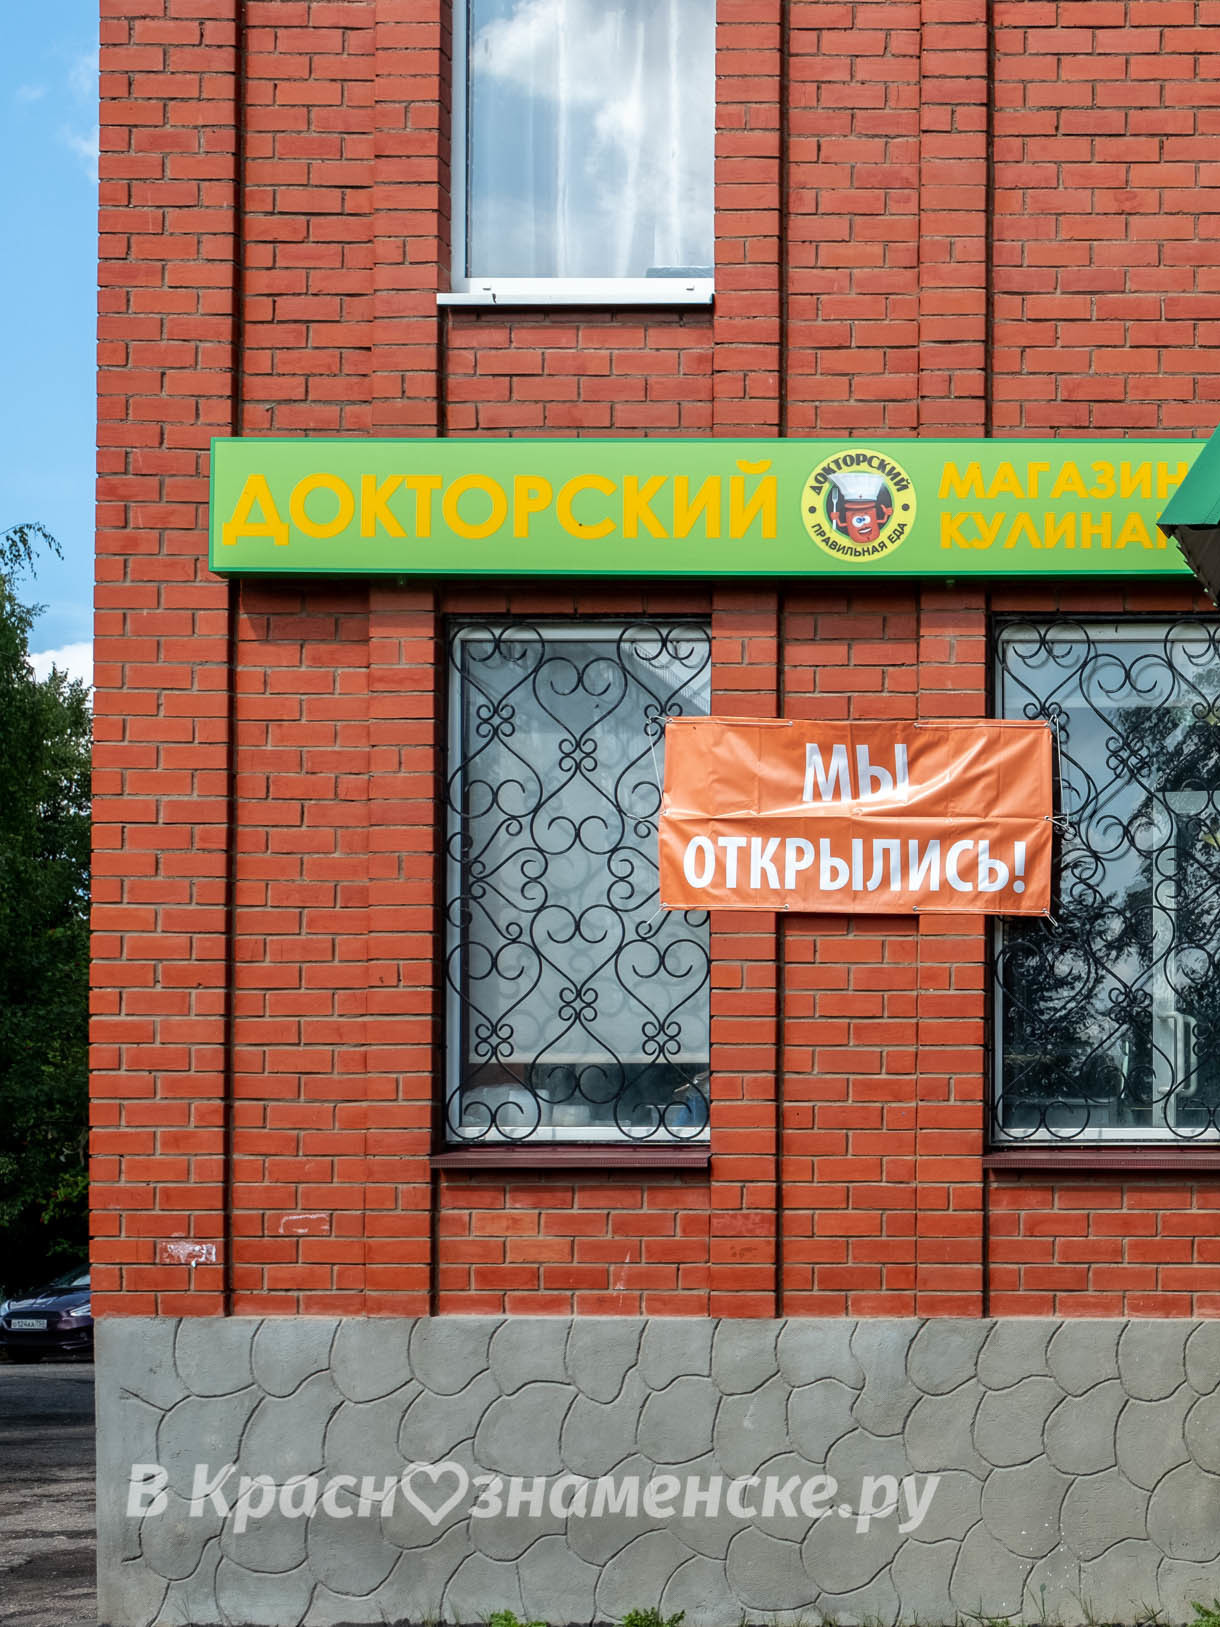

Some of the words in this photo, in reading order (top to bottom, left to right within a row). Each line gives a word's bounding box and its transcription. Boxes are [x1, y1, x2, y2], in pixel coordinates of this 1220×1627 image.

[222, 459, 778, 545] ДОКТОРСКИЙ
[809, 453, 911, 496] ДОКТОРСКИЙ
[938, 461, 1189, 519] МАГАЗИН
[811, 523, 888, 557] ПРАВИЛЬНАЯ
[887, 522, 908, 544] ЕДА
[802, 743, 909, 802] МЫ
[683, 836, 1027, 894] ОТКРЫЛИСЬ!
